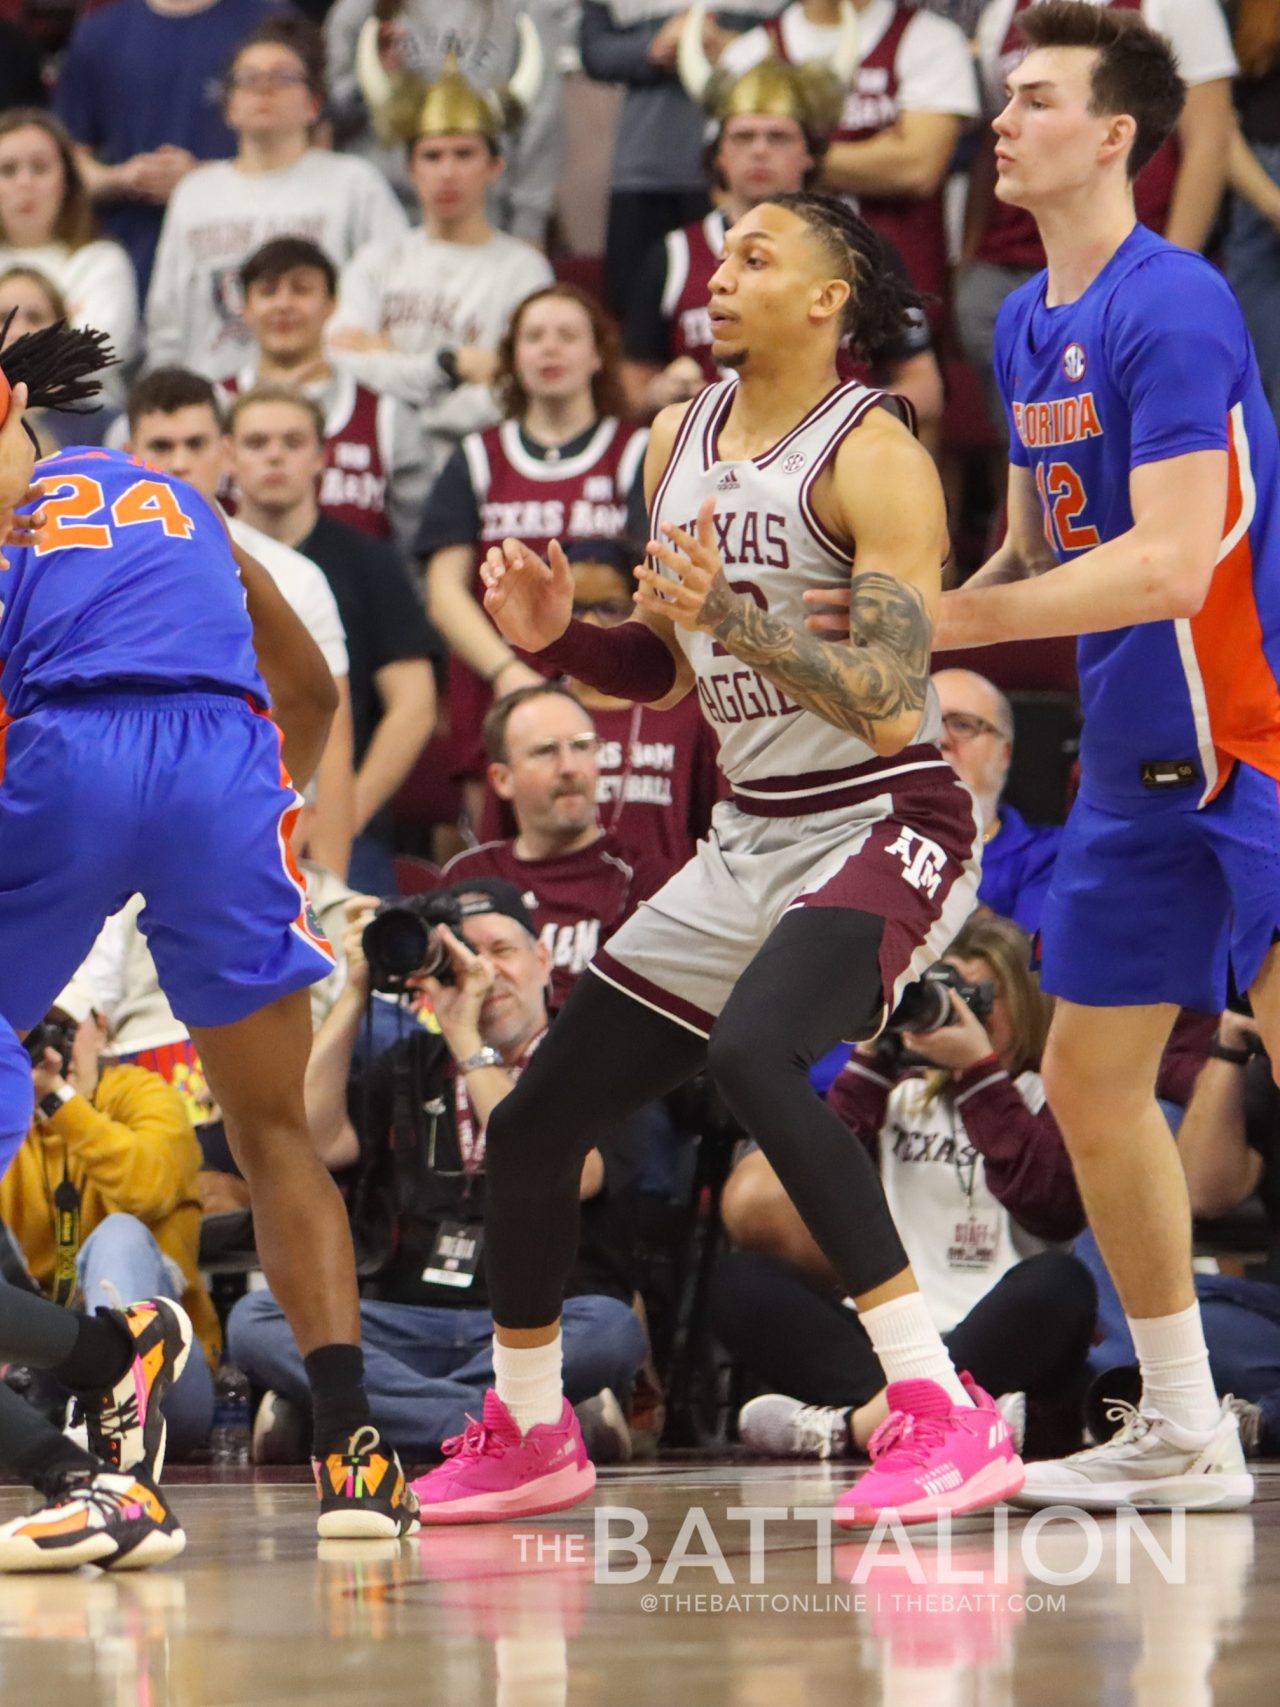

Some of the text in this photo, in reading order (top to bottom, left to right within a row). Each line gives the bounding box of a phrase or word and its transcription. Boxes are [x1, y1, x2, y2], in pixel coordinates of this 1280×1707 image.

[1012, 392, 1103, 448] FORIDA
[29, 473, 196, 557] 24
[668, 511, 790, 582] TXAS
